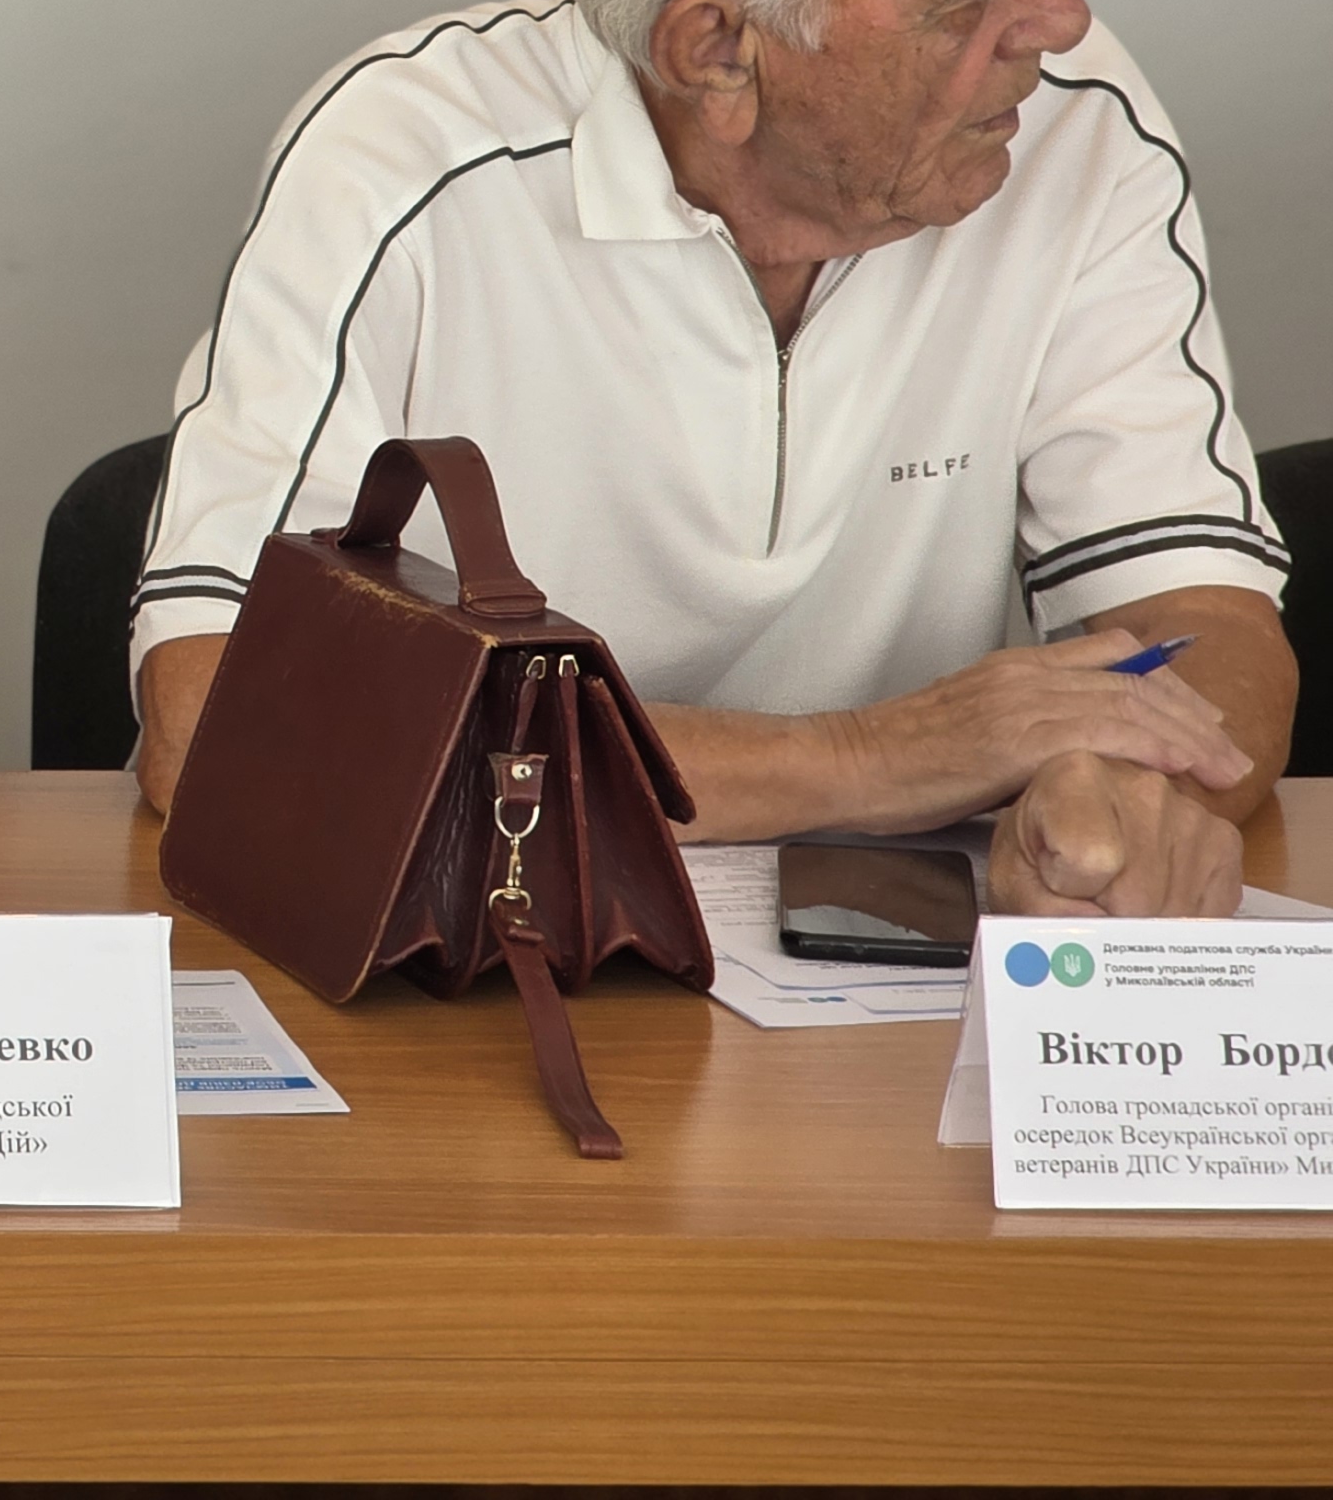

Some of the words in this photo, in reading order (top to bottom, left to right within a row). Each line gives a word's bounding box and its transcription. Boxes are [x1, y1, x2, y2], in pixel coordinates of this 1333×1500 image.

[890, 453, 971, 483] BELFE
[1102, 942, 1166, 955] Державна
[1168, 945, 1233, 955] податкова
[1235, 944, 1283, 957] служба
[1104, 962, 1155, 974] Головне
[1157, 964, 1227, 976] управління
[1229, 964, 1256, 976] ДПС
[1115, 975, 1206, 987] Миколаївській
[1208, 975, 1255, 988] області
[1038, 1031, 1183, 1075] Віктор
[1219, 1033, 1333, 1075] Борд
[1040, 1095, 1119, 1115] Голова
[1124, 1097, 1259, 1121] громадської
[1014, 1129, 1114, 1149] осередок
[1119, 1125, 1288, 1150] Всеукраїнської
[1014, 1154, 1119, 1179] ветеранів
[1125, 1154, 1179, 1178] ДПС
[1185, 1154, 1289, 1180] України»
